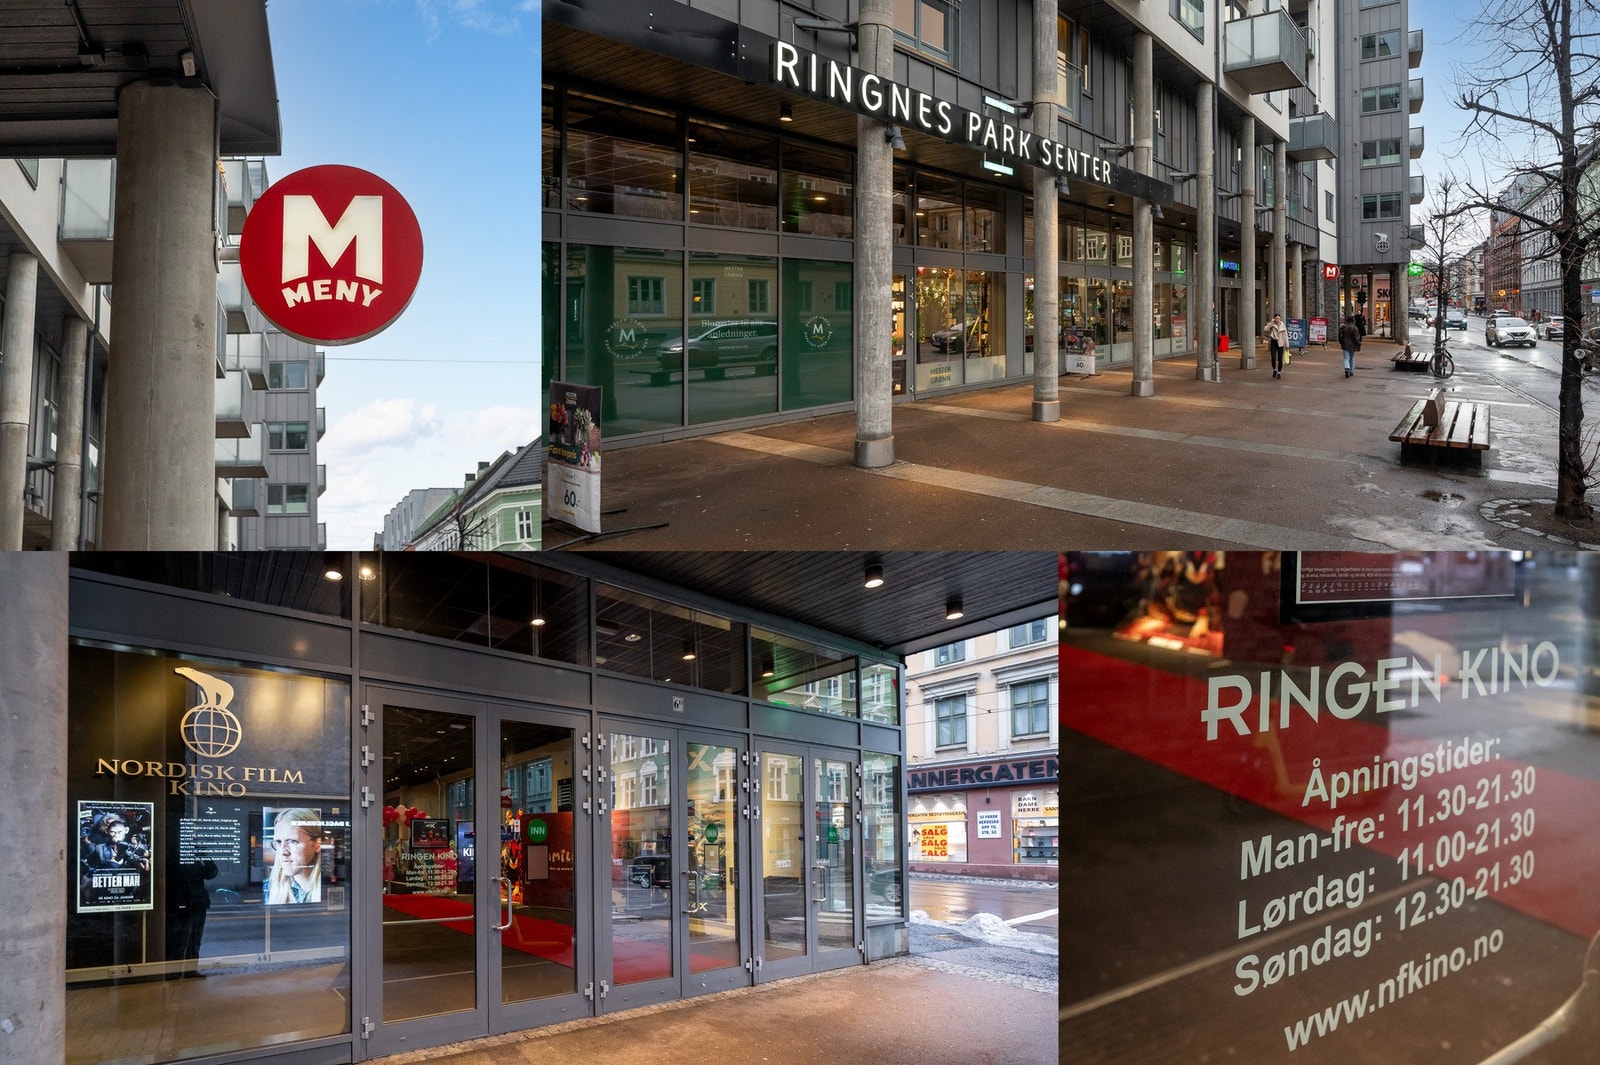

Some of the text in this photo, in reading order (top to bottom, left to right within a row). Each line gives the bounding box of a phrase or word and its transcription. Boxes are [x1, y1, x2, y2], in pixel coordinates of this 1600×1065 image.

[777, 40, 1112, 185] RINGNES PARK SENTER
[282, 195, 383, 285] M
[281, 279, 383, 309] MENY
[619, 328, 636, 342] M
[812, 323, 823, 334] M
[1201, 640, 1560, 741] RINGEN KINO
[95, 758, 306, 784] NORDISK FILM
[169, 780, 247, 797] KINO
[1302, 737, 1501, 809] Åpningstider:
[530, 826, 545, 835] INN
[1240, 765, 1537, 881] Man-fre: 11.30-21.30
[92, 875, 140, 888] BETTER MAN
[401, 852, 458, 861] RINGEN KINO
[1237, 807, 1536, 940] Lørdag: 11.00-21.30
[1233, 849, 1536, 997] Søndag: 12.30-21.30
[1283, 928, 1505, 1053] www.nfkino.no
